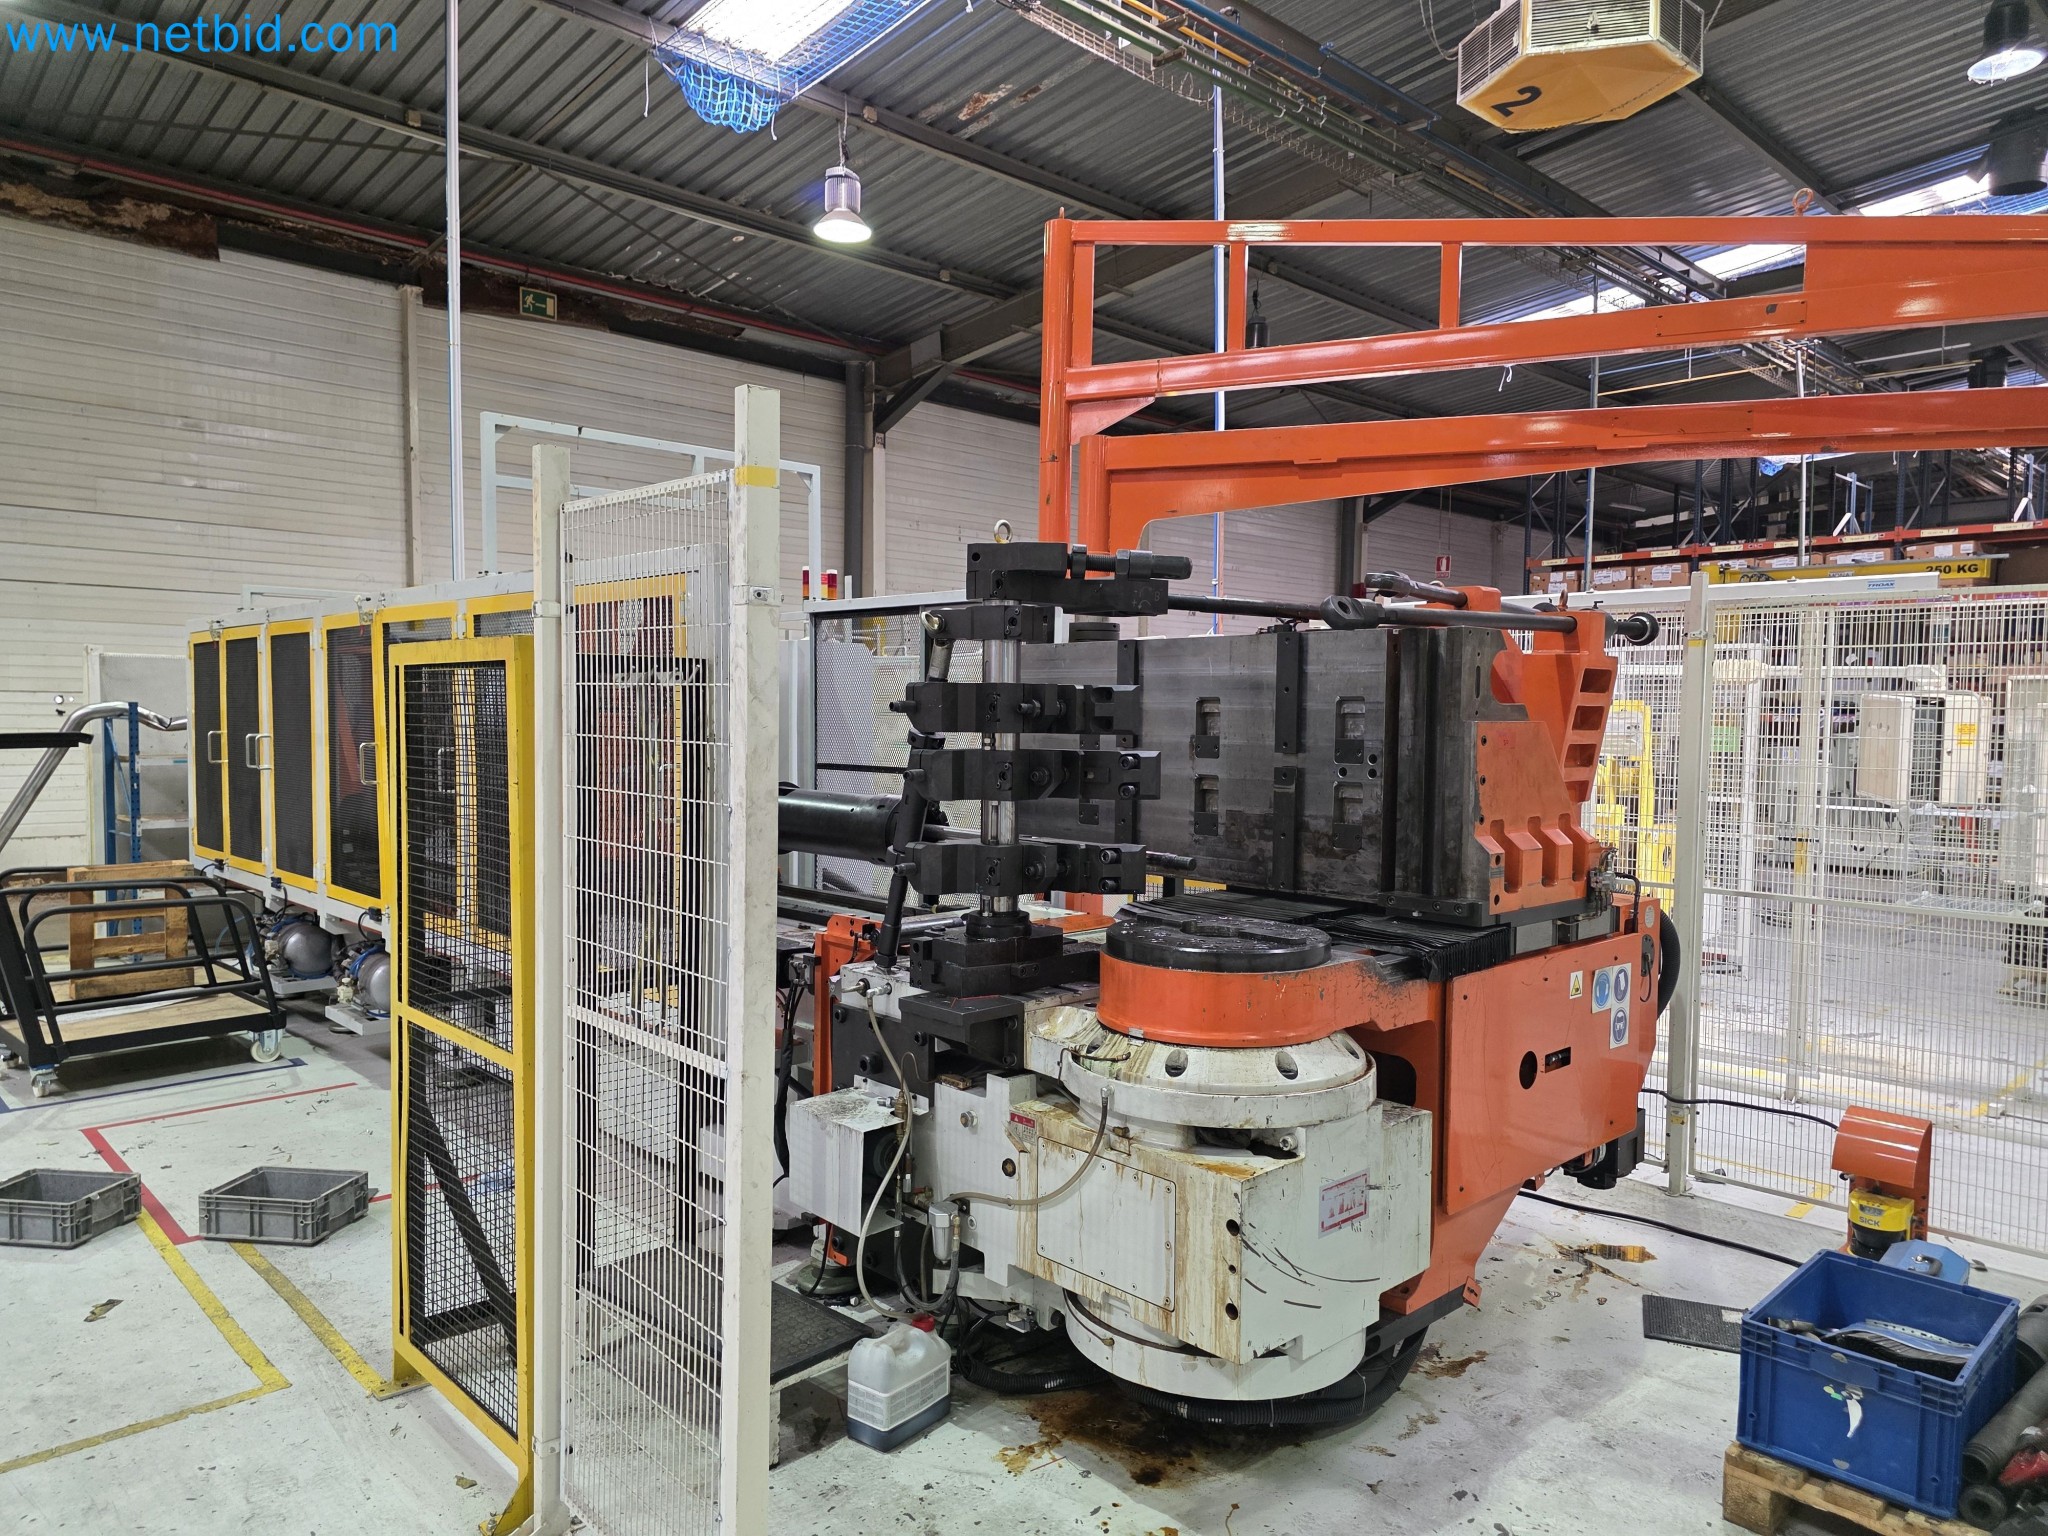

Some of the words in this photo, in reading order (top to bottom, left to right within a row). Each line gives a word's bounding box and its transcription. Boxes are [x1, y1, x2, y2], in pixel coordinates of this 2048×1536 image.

[1490, 85, 1543, 118] 2
[1925, 564, 1952, 575] 250
[1957, 563, 1979, 574] KG
[1858, 1216, 1881, 1228] SICK
